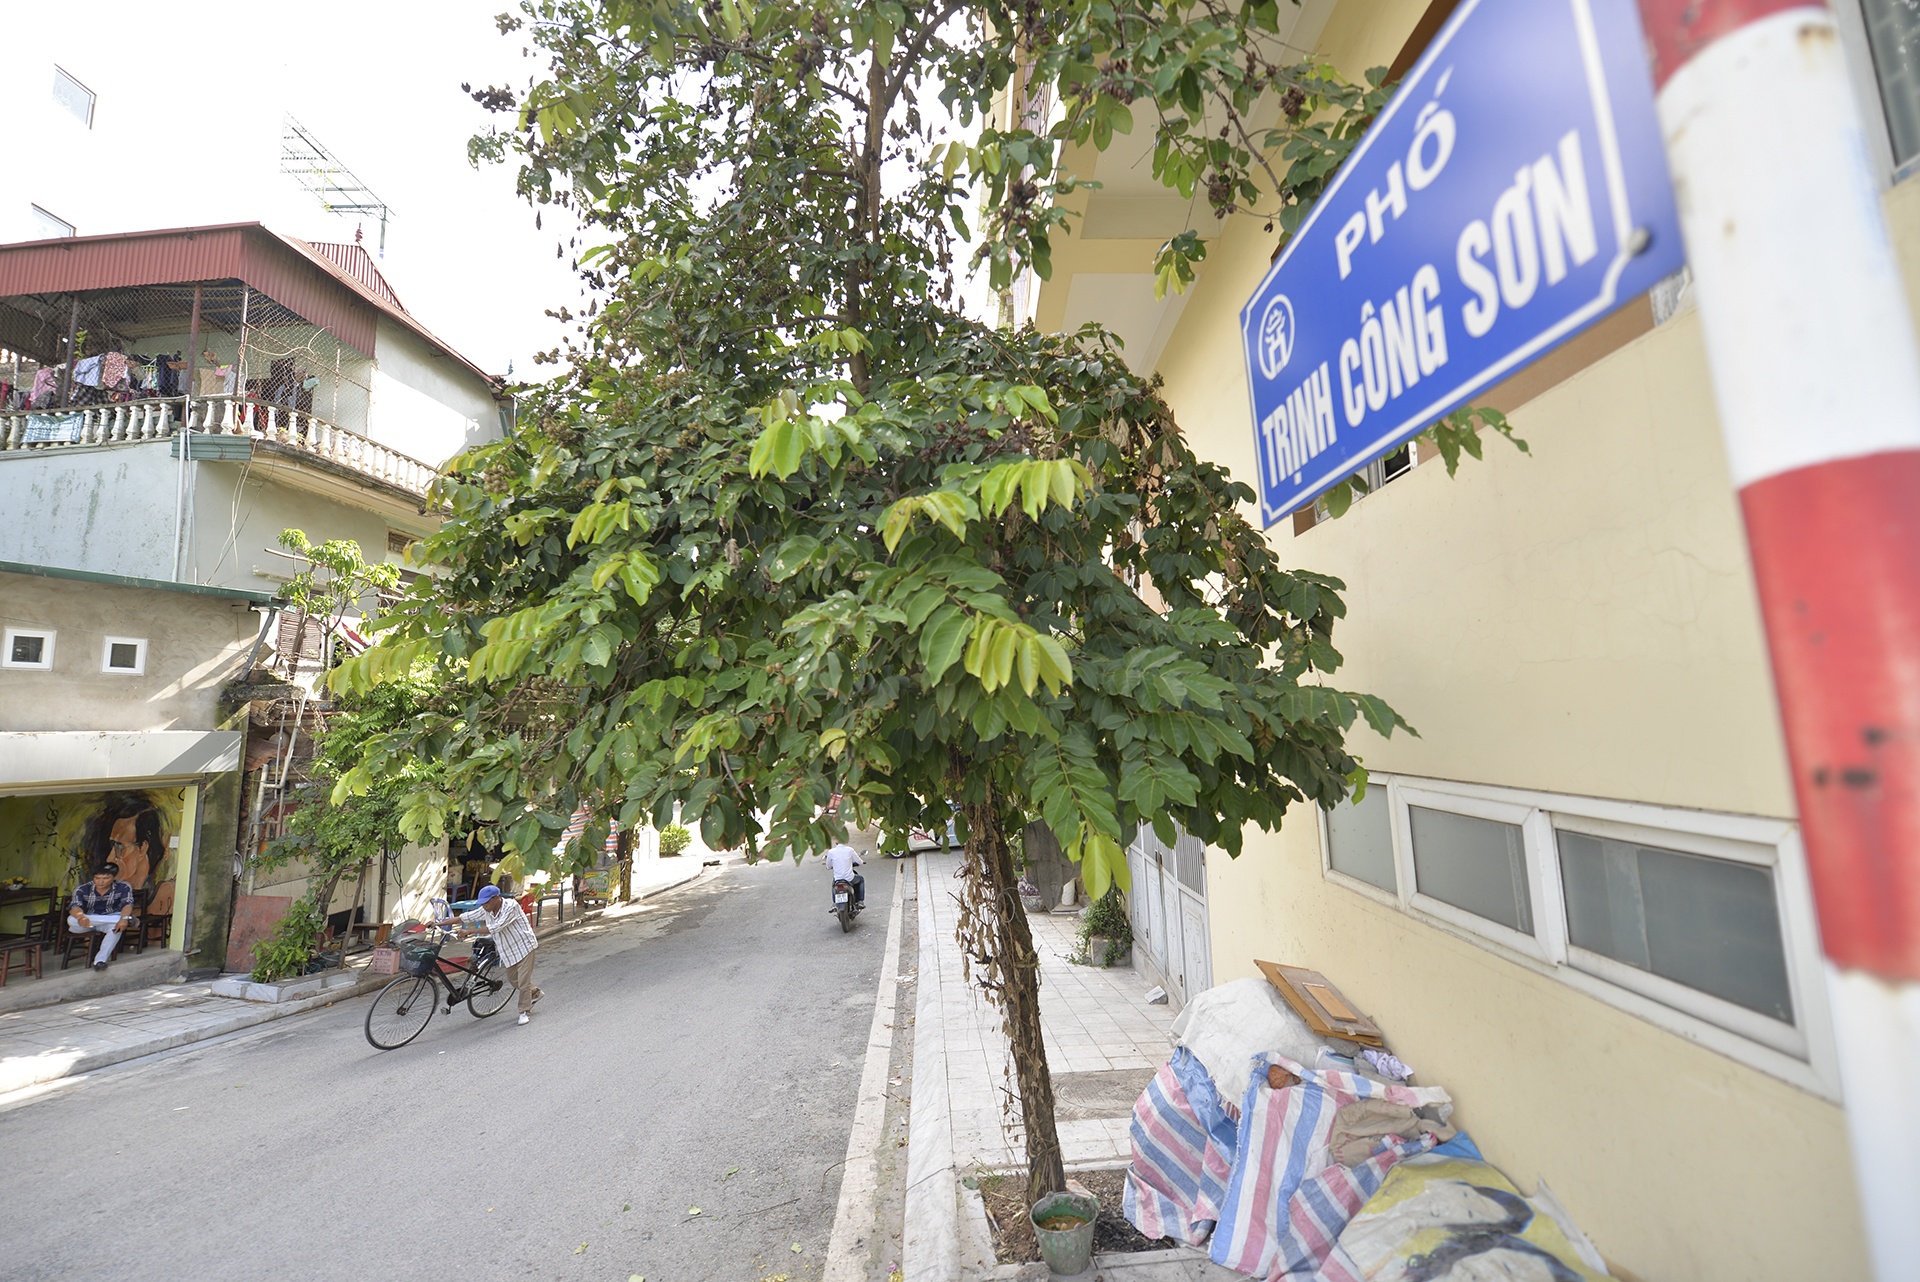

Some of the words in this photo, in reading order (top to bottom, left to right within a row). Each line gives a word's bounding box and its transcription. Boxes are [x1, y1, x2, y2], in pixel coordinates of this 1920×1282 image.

[1262, 361, 1337, 489] TRỊNH
[1339, 264, 1448, 428] CÔNG
[1456, 128, 1598, 338] SƠN
[1334, 64, 1456, 281] PHỐ
